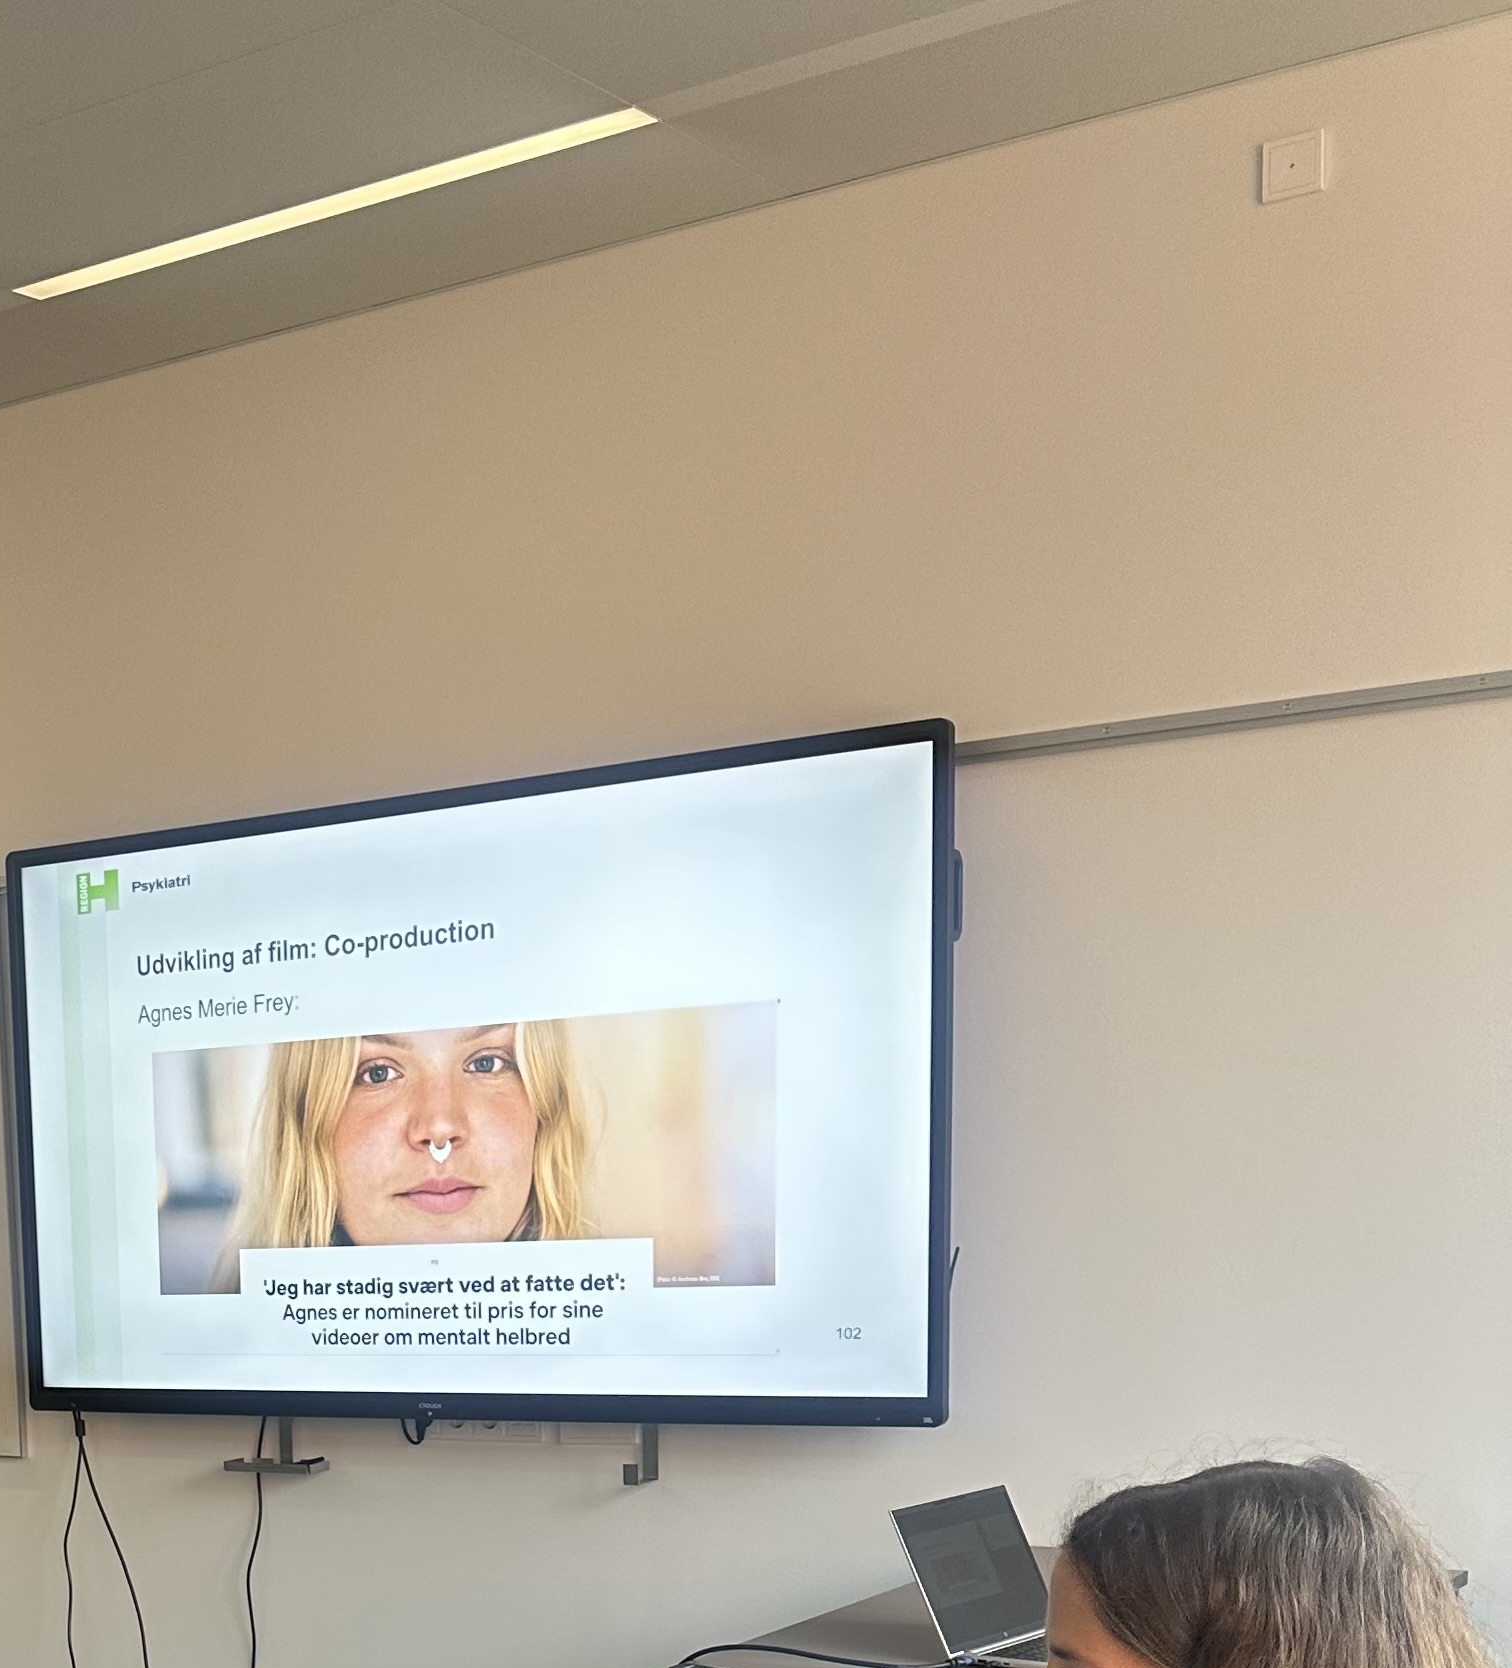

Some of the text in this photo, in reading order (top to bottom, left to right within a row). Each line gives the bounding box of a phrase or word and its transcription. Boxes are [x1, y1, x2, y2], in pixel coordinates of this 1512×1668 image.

[79, 875, 89, 913] REGION
[131, 874, 191, 893] Psykiatri
[137, 919, 494, 976] Udvikling af film: Co-production
[138, 993, 300, 1027] Agnes Merie Frey:
[263, 1273, 626, 1300] 'Jeg har stadig svært ved at fatte det':
[283, 1300, 604, 1325] Agnes er nomineret til pris for sine
[311, 1327, 571, 1345] videoer om mentalt helbred
[836, 1327, 862, 1340] 102
